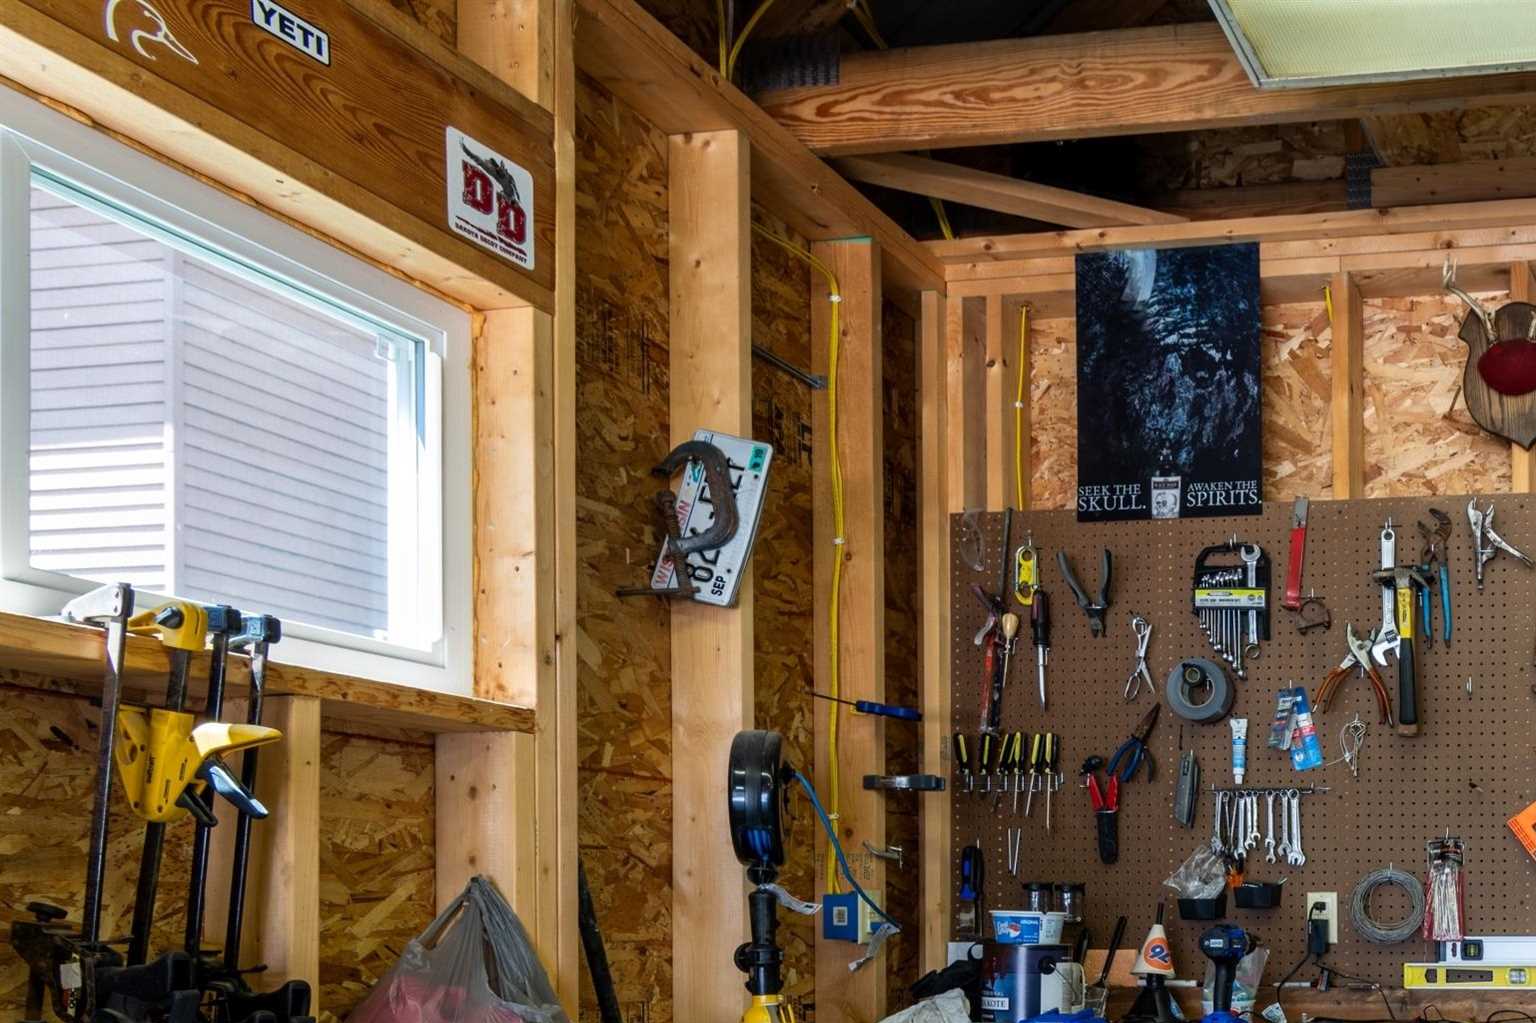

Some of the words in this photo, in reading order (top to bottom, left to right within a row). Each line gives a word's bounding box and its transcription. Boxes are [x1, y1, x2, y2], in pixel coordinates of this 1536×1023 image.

[256, 0, 324, 57] YETI
[1078, 485, 1111, 496] SEEK
[1113, 483, 1142, 495] THE
[1187, 481, 1234, 492] AWAKEN
[1235, 480, 1258, 490] THE
[1078, 495, 1147, 512] SKULL.
[1186, 489, 1263, 508] SPIRITS.
[711, 575, 727, 597] SEP
